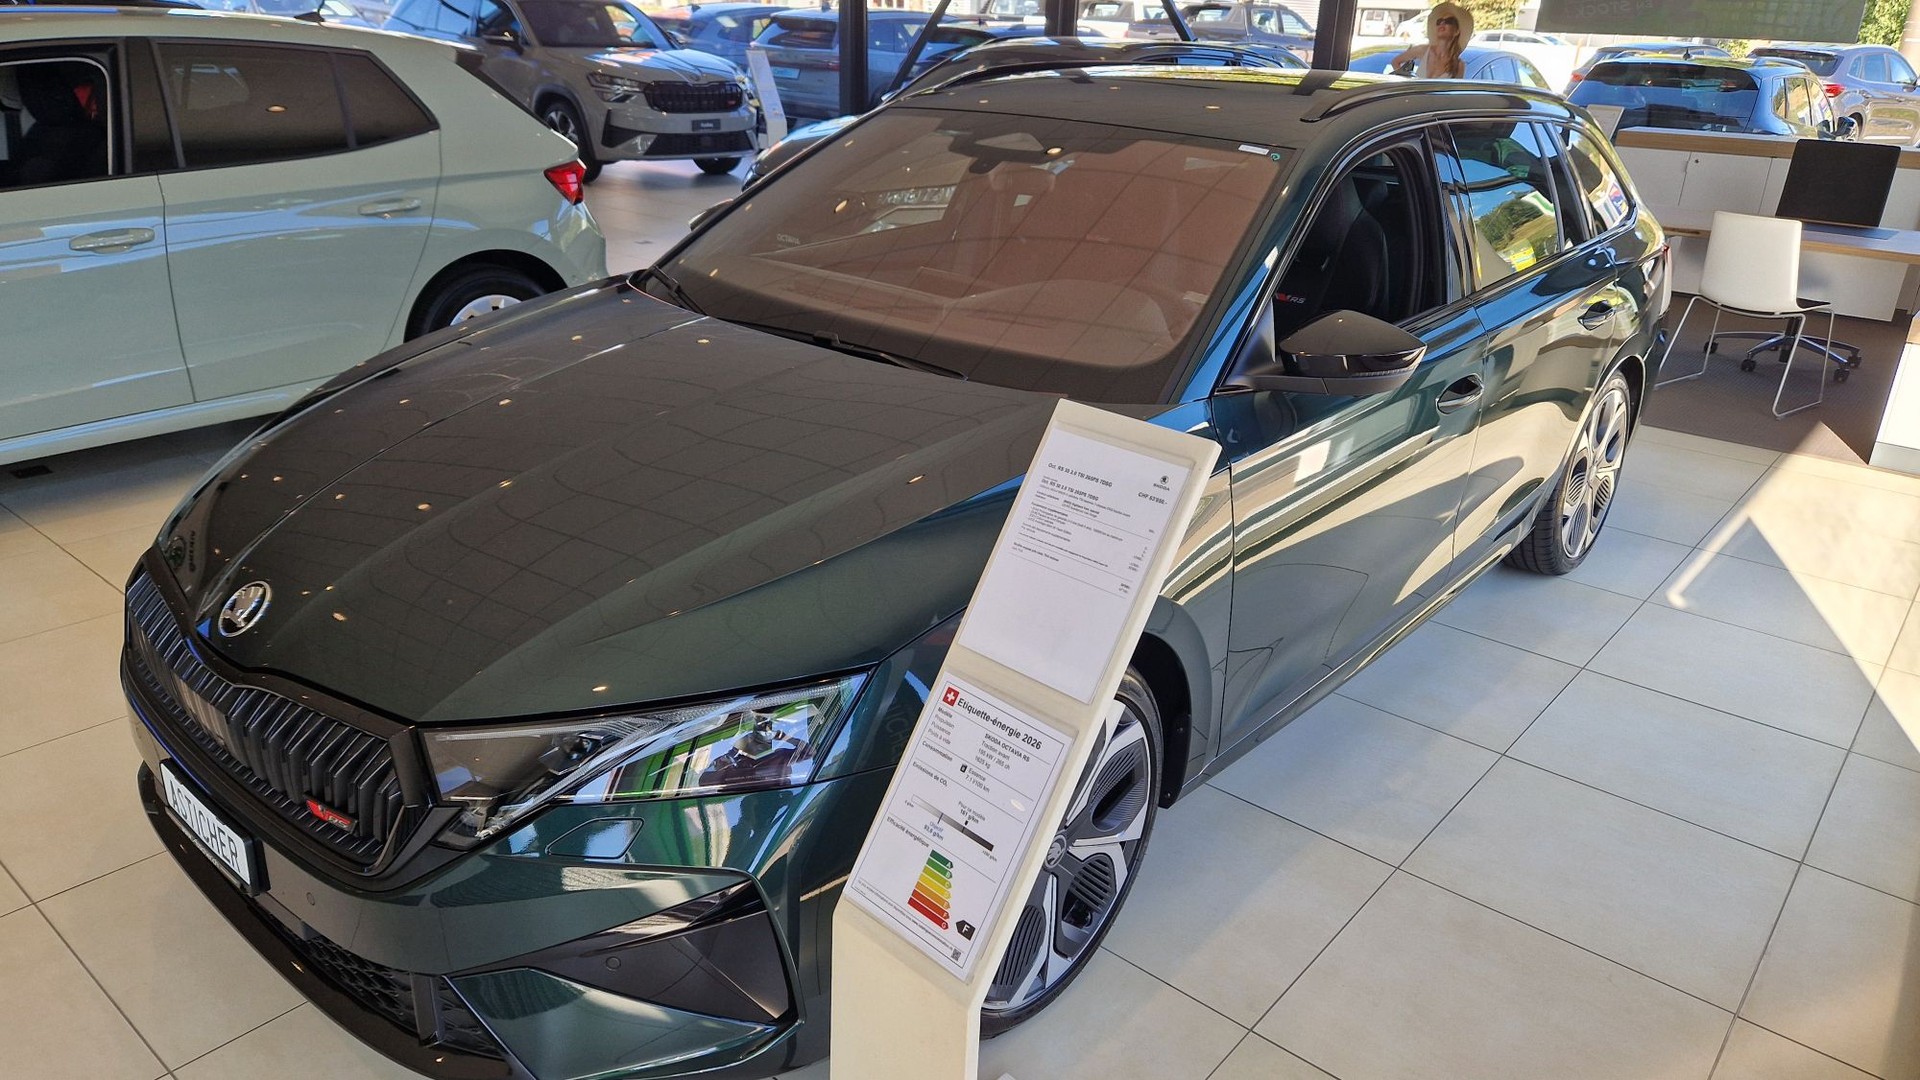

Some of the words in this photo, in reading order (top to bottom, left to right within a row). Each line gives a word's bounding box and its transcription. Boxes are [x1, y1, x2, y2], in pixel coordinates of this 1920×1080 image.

[958, 698, 1021, 738] Etiquette-énergie
[1022, 734, 1042, 750] 2026
[1001, 743, 1022, 758] OCTAVIA
[969, 768, 985, 781] Essence
[170, 780, 240, 873] ASTICHER
[962, 924, 970, 933] F
